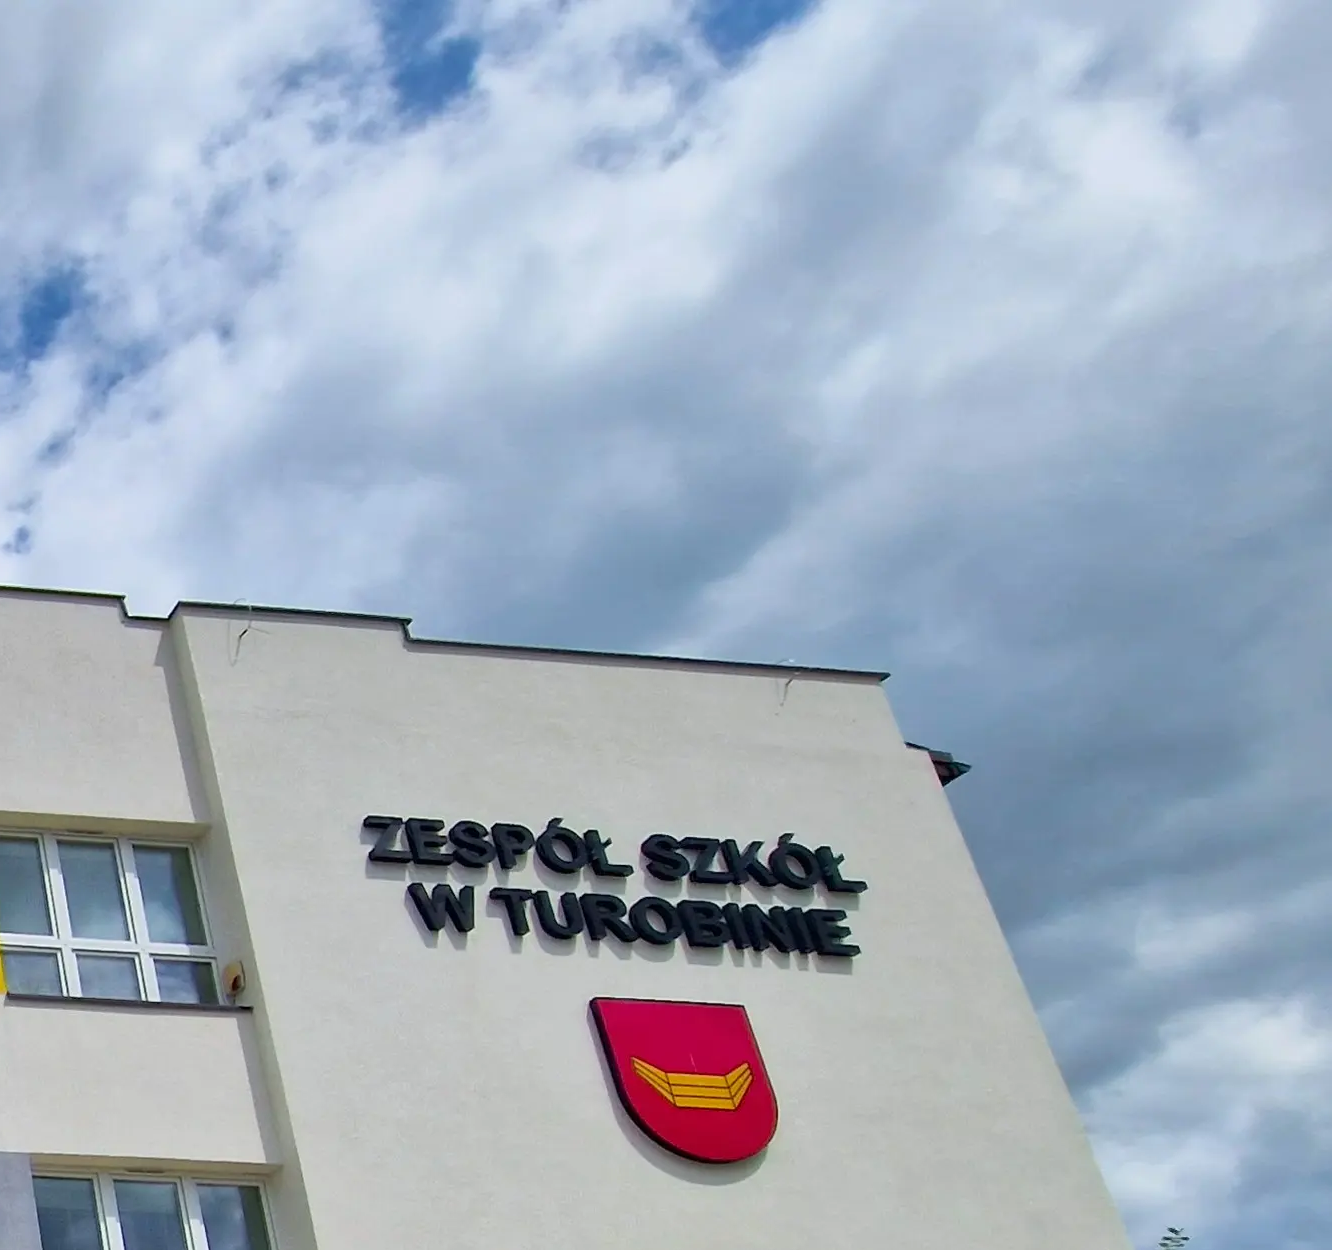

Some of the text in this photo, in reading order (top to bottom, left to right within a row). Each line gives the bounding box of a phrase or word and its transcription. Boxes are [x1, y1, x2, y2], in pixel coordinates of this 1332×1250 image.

[362, 815, 869, 894] ZESPÓŁ SZKÓŁ
[407, 882, 862, 957] W TUROBINIE
